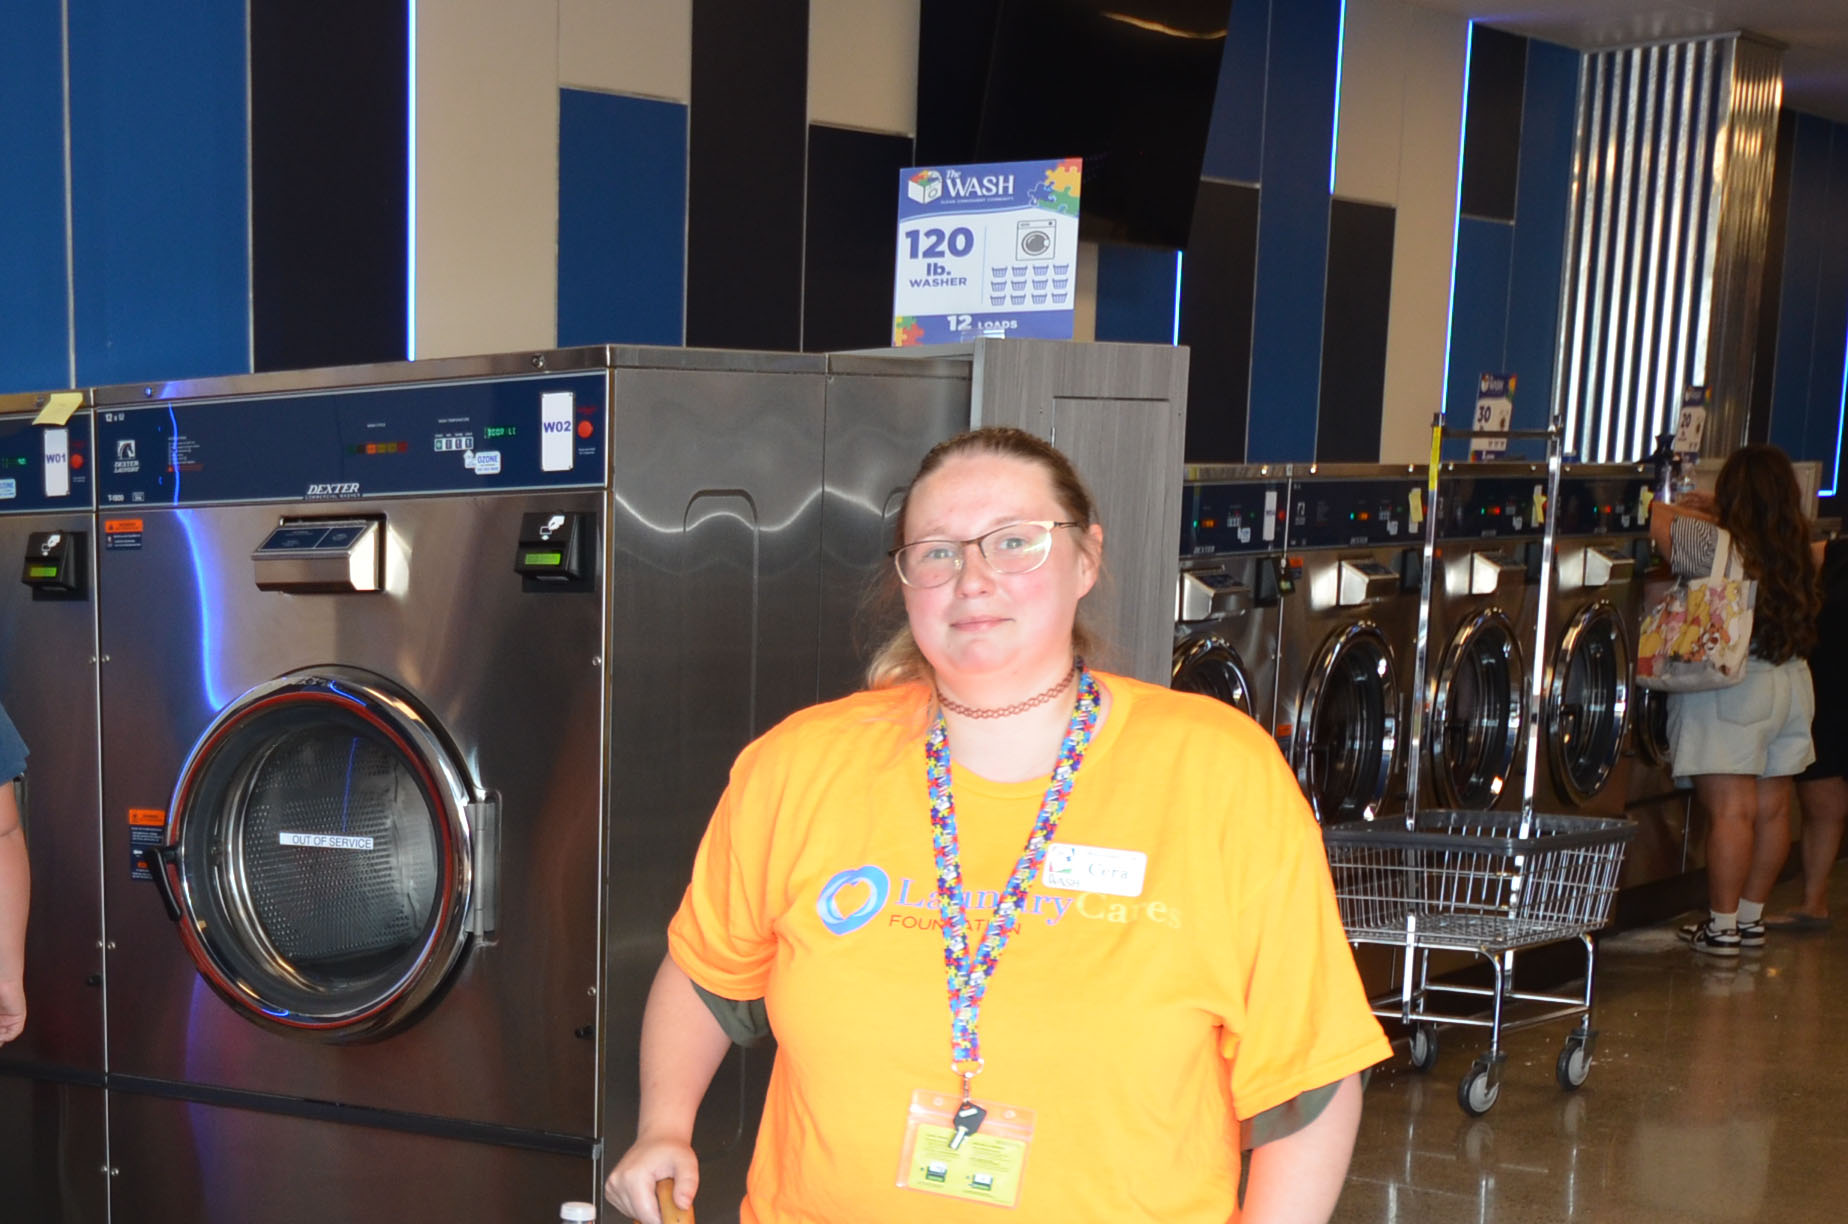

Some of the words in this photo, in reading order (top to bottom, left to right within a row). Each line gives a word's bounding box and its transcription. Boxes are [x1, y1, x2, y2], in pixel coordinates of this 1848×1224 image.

[945, 174, 1015, 198] WASH
[905, 227, 974, 260] 120
[925, 263, 952, 277] lb.
[909, 277, 968, 288] WASHER
[947, 315, 973, 332] 12
[978, 319, 1019, 330] LOADS
[1477, 405, 1492, 423] 30
[543, 420, 572, 433] W02
[46, 453, 67, 465] W01
[477, 454, 498, 464] OZONE
[307, 483, 360, 495] DEXTER
[291, 834, 312, 845] OUT
[313, 835, 327, 846] OF
[327, 837, 373, 849] SERVICE
